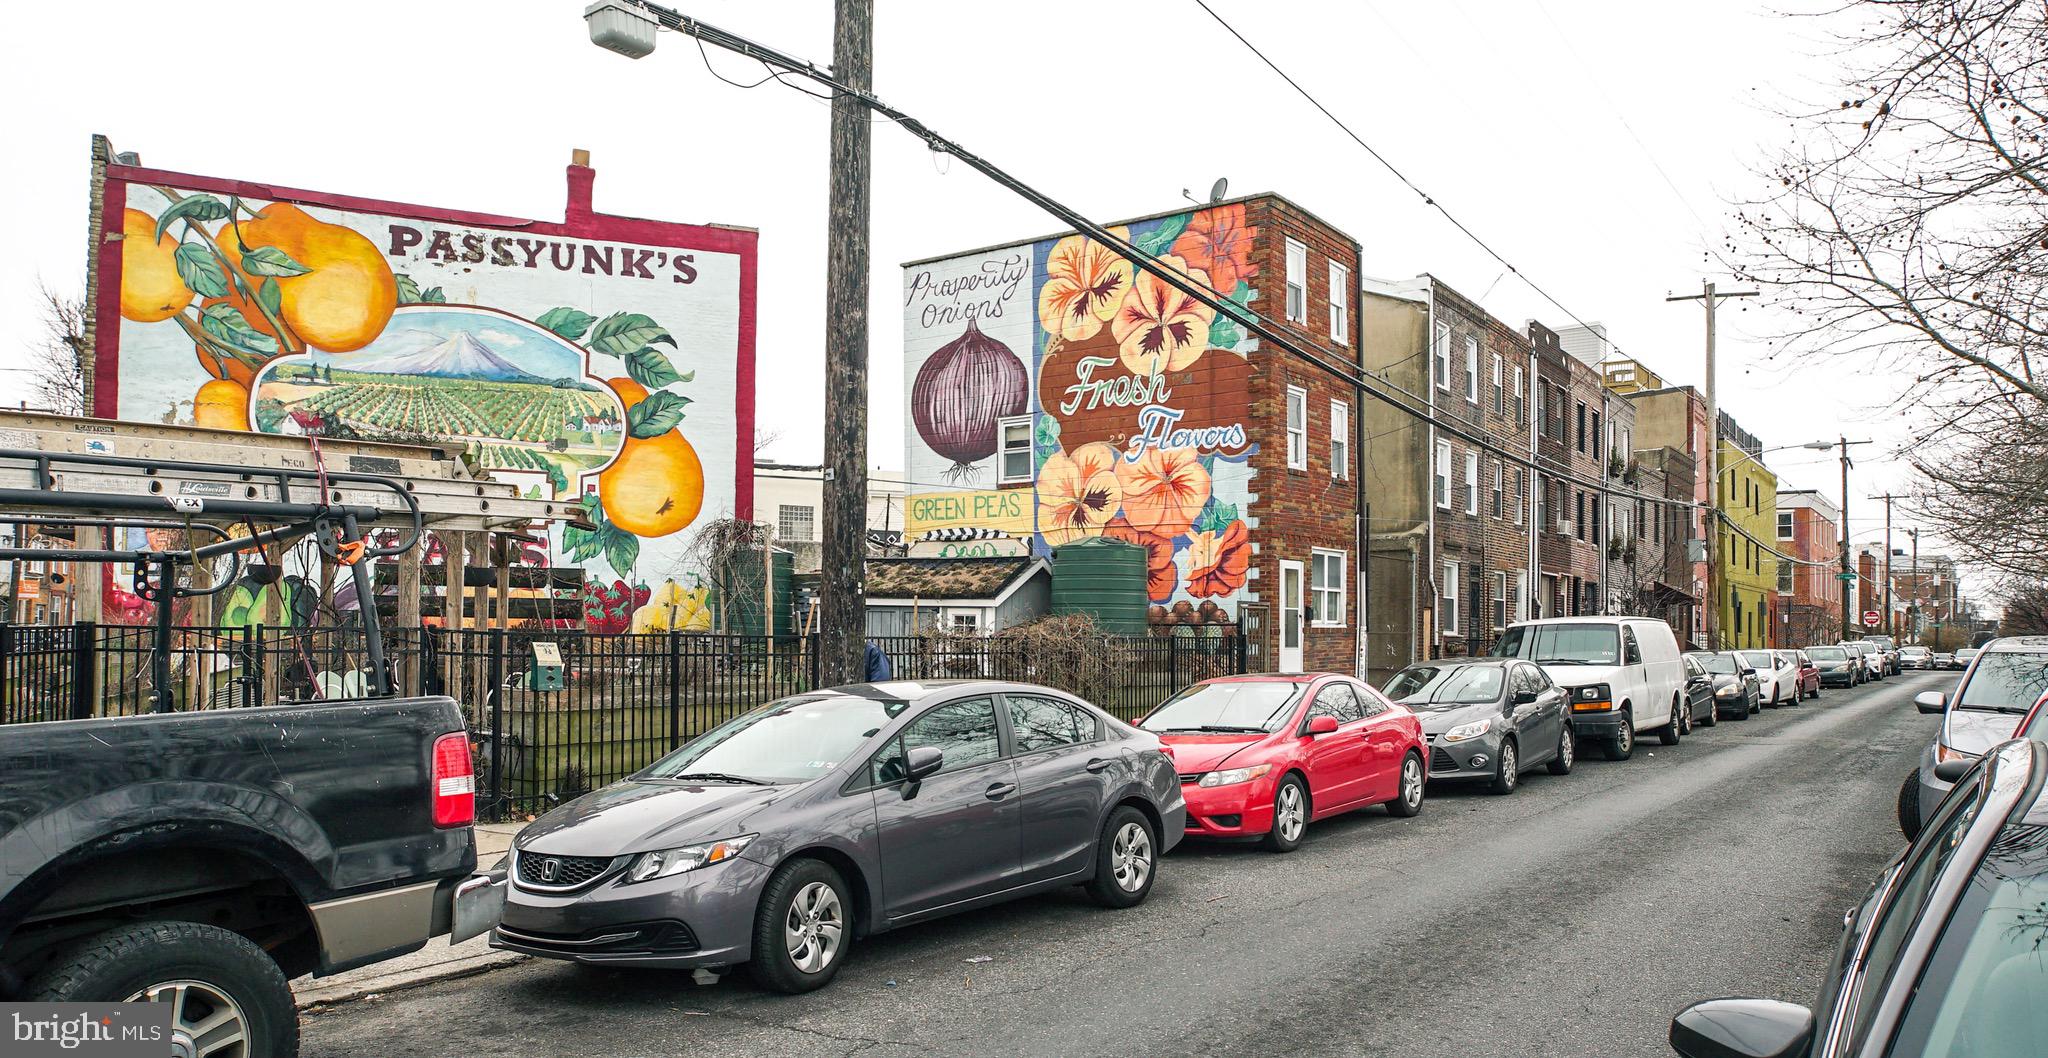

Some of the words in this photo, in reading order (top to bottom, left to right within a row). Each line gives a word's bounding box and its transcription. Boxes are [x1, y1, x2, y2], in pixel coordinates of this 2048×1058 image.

[388, 224, 698, 284] PASSYUNK'S
[906, 254, 1029, 307] Prosperity
[921, 296, 1003, 329] Onions
[1060, 355, 1172, 416] Fresh
[1124, 404, 1247, 464] Flowers
[913, 497, 966, 521] GREEN
[973, 493, 1021, 519] PEAS
